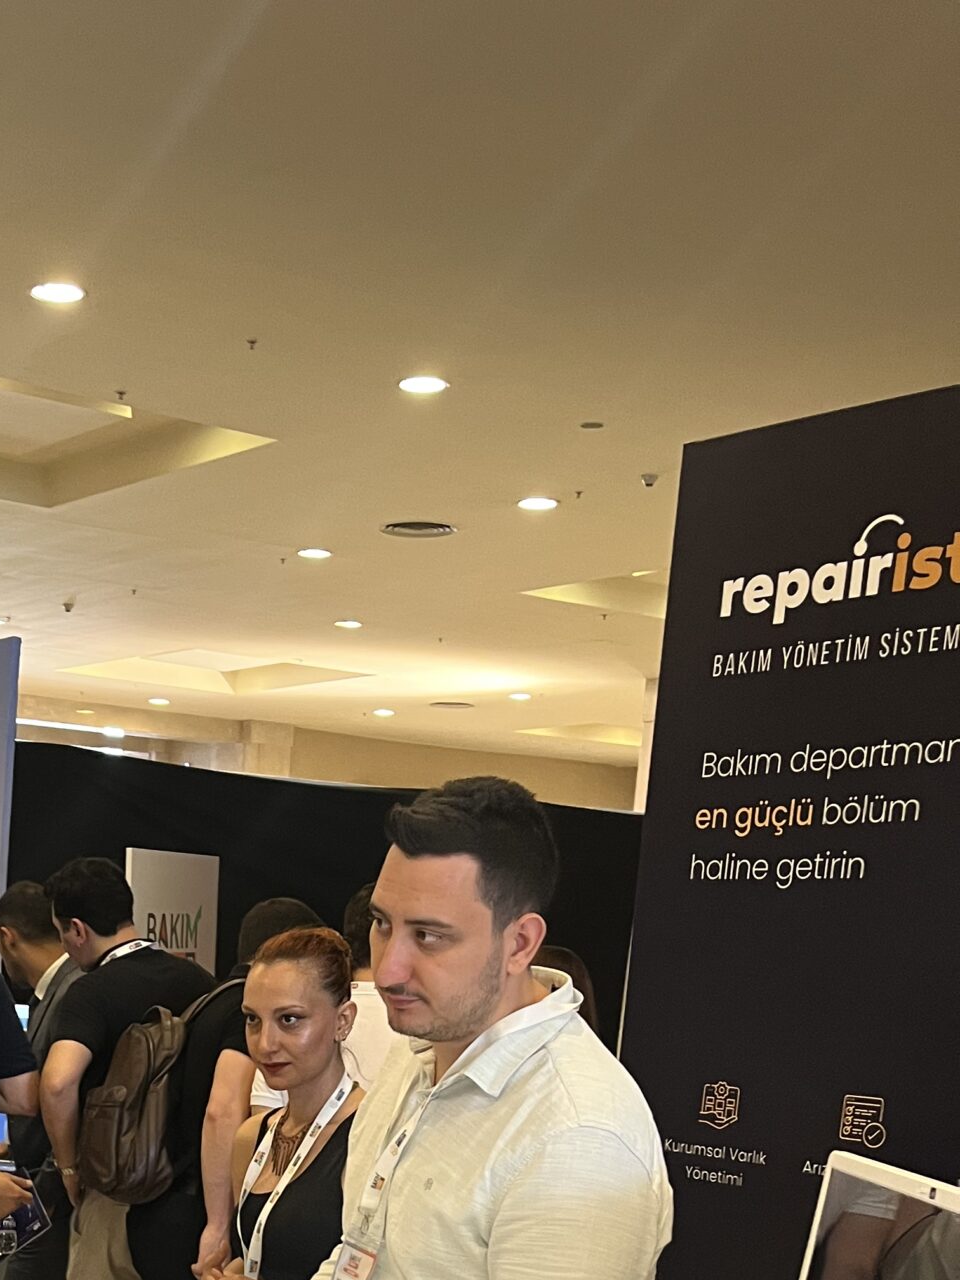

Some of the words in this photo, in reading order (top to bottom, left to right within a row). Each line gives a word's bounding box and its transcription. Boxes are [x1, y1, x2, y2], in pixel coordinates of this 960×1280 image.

[712, 648, 772, 678] BAKIM
[782, 634, 870, 670] YÖNETİM
[702, 749, 782, 779] Bakım
[695, 807, 728, 830] en
[734, 798, 814, 838] güçlü
[822, 794, 920, 826] bölüm
[689, 852, 769, 880] haline
[776, 850, 866, 889] getirin
[664, 1137, 726, 1161] Kurumsal
[729, 1147, 768, 1166] Varlık
[685, 1164, 743, 1187] Yönetimi
